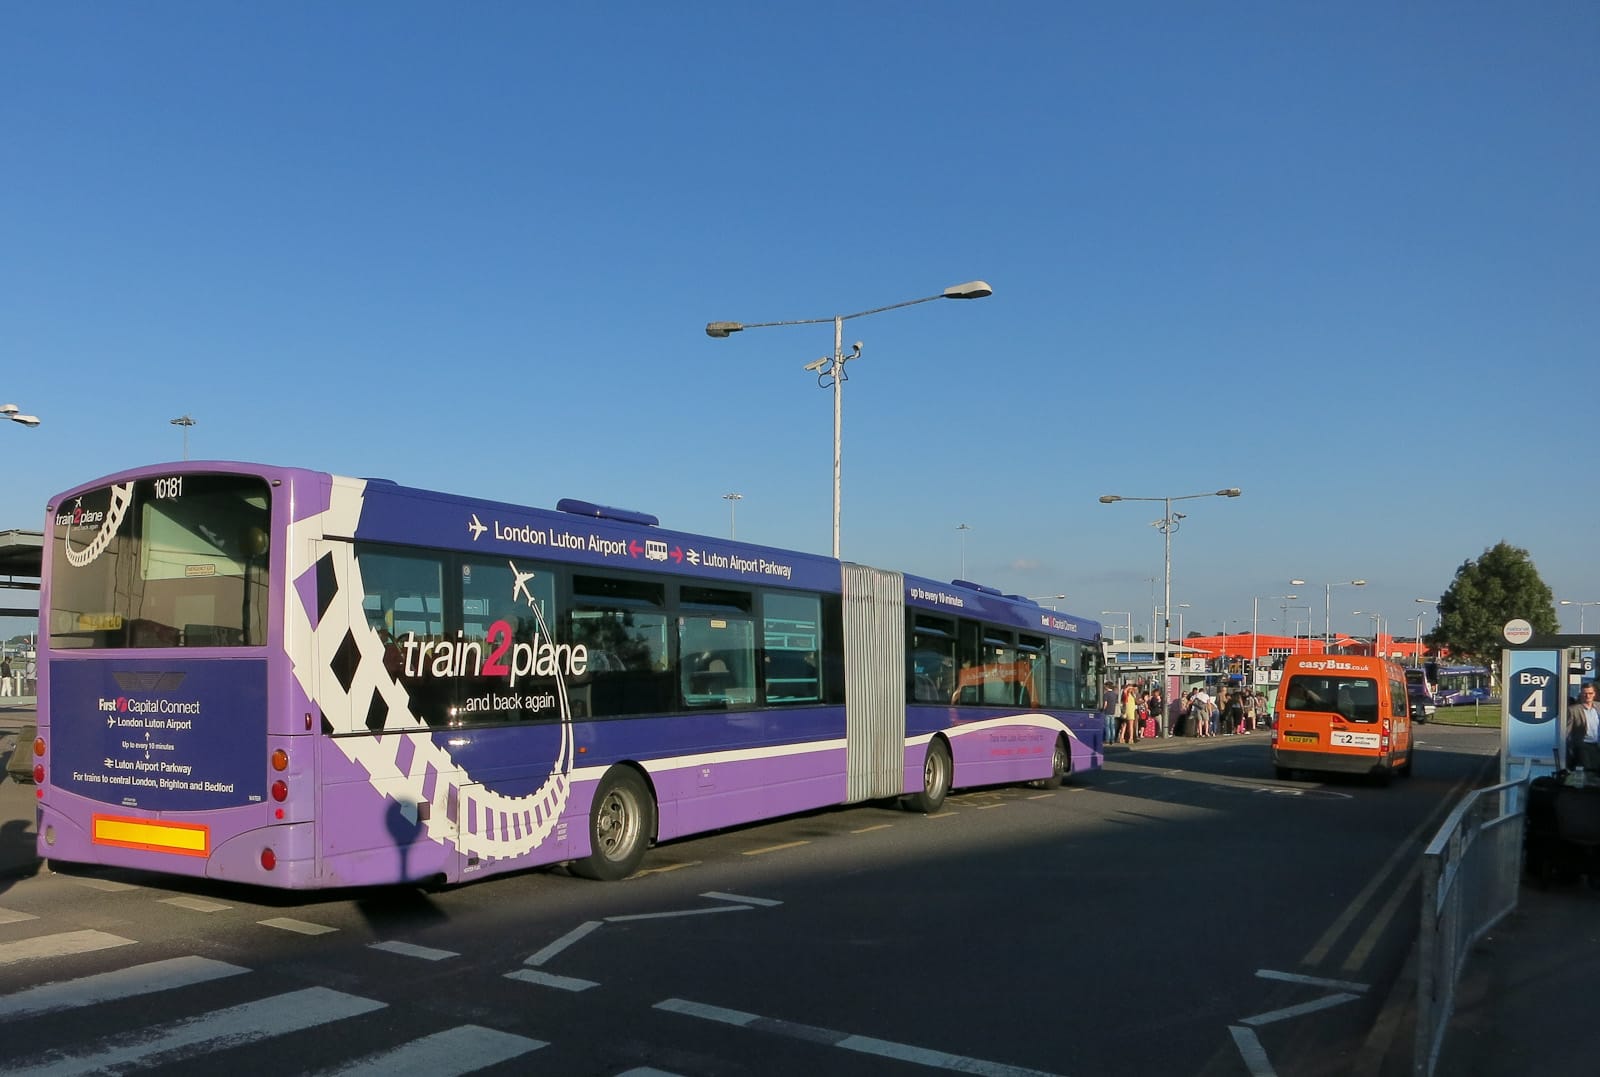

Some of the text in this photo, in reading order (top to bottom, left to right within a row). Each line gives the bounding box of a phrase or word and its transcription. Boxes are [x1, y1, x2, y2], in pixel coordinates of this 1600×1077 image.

[154, 476, 182, 499] 10181
[55, 508, 103, 526] train2plane
[494, 520, 627, 557] London Luton Airport
[702, 550, 792, 580] Luton Airport Parkway
[910, 588, 918, 600] up
[918, 587, 925, 599] to
[924, 591, 938, 605] every
[945, 594, 963, 608] minutes
[403, 619, 588, 688] train2plane
[1170, 663, 1176, 671] 2
[1195, 663, 1201, 671] 2
[1299, 659, 1369, 671] easyBus.co.uk
[1584, 661, 1592, 670] 6
[1520, 673, 1549, 687] Bay
[98, 698, 200, 715] First Capital Connect
[494, 693, 523, 710] back
[525, 692, 555, 712] again
[1521, 690, 1547, 719] 4
[117, 717, 192, 731] London Luton Airport
[122, 740, 129, 749] Up
[135, 742, 148, 751] every
[155, 741, 175, 751] minutes
[115, 759, 192, 775] Luton Airport Parkway
[73, 772, 234, 793] For trains to central London, Brighton and Bedford
